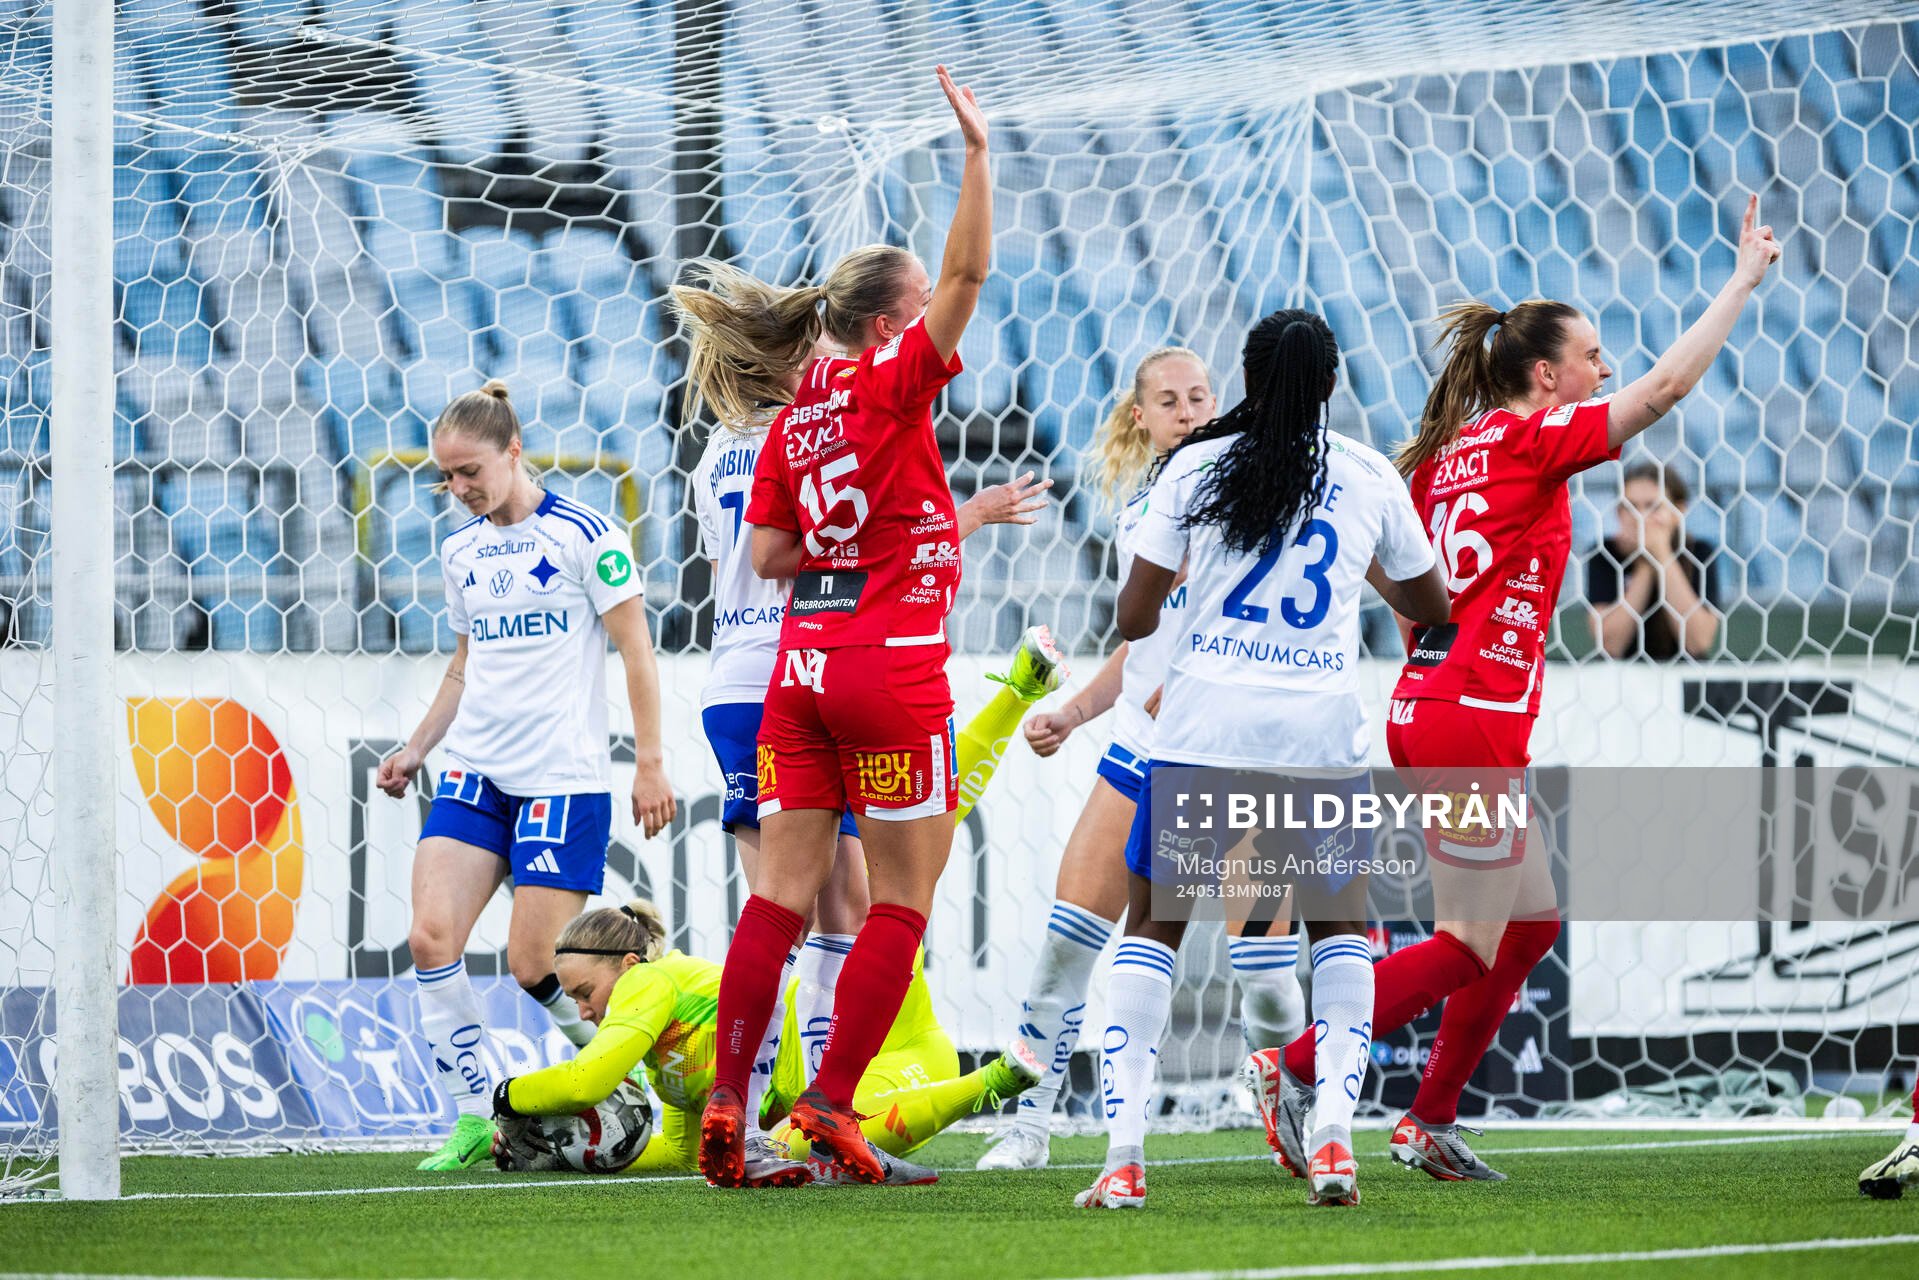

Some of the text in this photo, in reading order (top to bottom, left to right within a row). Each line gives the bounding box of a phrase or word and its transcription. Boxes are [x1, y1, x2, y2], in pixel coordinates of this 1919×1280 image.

[1433, 448, 1489, 487] EXACT
[719, 491, 744, 552] 7
[799, 453, 869, 558] 15
[920, 513, 946, 525] KAFFE
[910, 520, 954, 535] KOMPANIET
[1430, 492, 1493, 594] 16
[475, 539, 536, 559] stadium
[832, 557, 859, 568] group
[1222, 519, 1338, 629] 23
[793, 598, 857, 610] ÖREBROPORTEN
[1192, 634, 1344, 671] PLATINUMCARS
[1479, 648, 1532, 672] KOMPANIET
[1491, 643, 1523, 659] KAFFE
[860, 791, 912, 802] AGENCY
[731, 1018, 745, 1056] umbro
[823, 1014, 839, 1051] umbro
[450, 1024, 486, 1095] Ocab
[1103, 1025, 1129, 1119] Ocab
[1425, 1039, 1444, 1079] umbro
